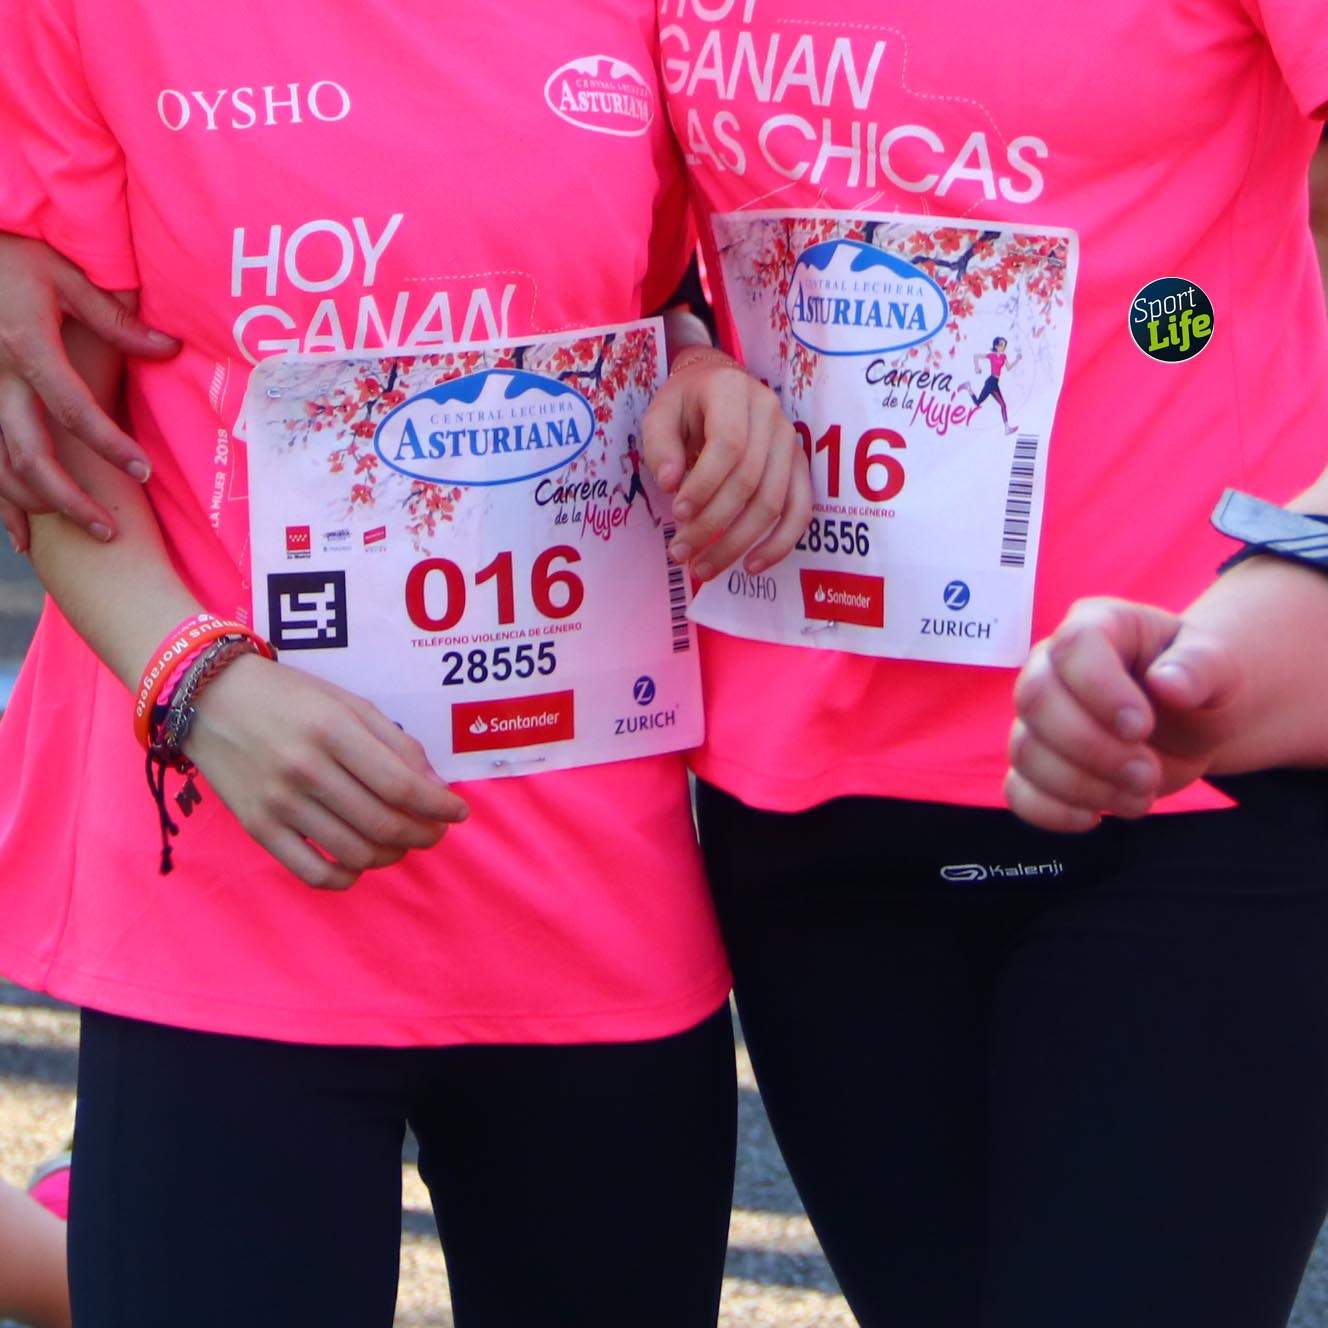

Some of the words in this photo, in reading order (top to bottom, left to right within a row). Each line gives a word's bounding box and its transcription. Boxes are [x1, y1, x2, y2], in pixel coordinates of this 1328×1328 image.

[659, 25, 886, 110] GANAN
[157, 79, 351, 131] OYSHO
[559, 79, 649, 122] ASTURIANA
[686, 110, 747, 176] AS
[758, 113, 1048, 204] CHICAS
[230, 212, 404, 298] HOY
[230, 283, 516, 366] GANAN
[791, 280, 929, 332] ASTURIANA
[1134, 286, 1196, 325] Sport
[1147, 312, 1212, 353] Life
[865, 358, 953, 391] Carrera
[430, 411, 504, 425] CENTRAL
[510, 401, 574, 418] LECHERA
[882, 392, 899, 410] de
[901, 389, 915, 410] la
[910, 390, 981, 436] Mujer
[393, 417, 582, 461] ASTURIANA
[535, 478, 608, 506] Carrera
[554, 505, 569, 525] de
[571, 502, 581, 523] la
[580, 495, 633, 541] Mujer
[405, 544, 584, 632] 016
[728, 570, 777, 602] OYSHO
[827, 587, 870, 609] Santander
[411, 635, 469, 647] TELÉFONO
[471, 630, 527, 643] VIOLENCIA
[528, 627, 542, 637] DE
[543, 622, 582, 635] GÉNERO
[920, 617, 991, 639] ZURICH
[442, 640, 557, 686] 28555
[490, 711, 559, 733] Santander
[614, 710, 675, 735] ZURICH
[989, 859, 1063, 877] Kalenji
